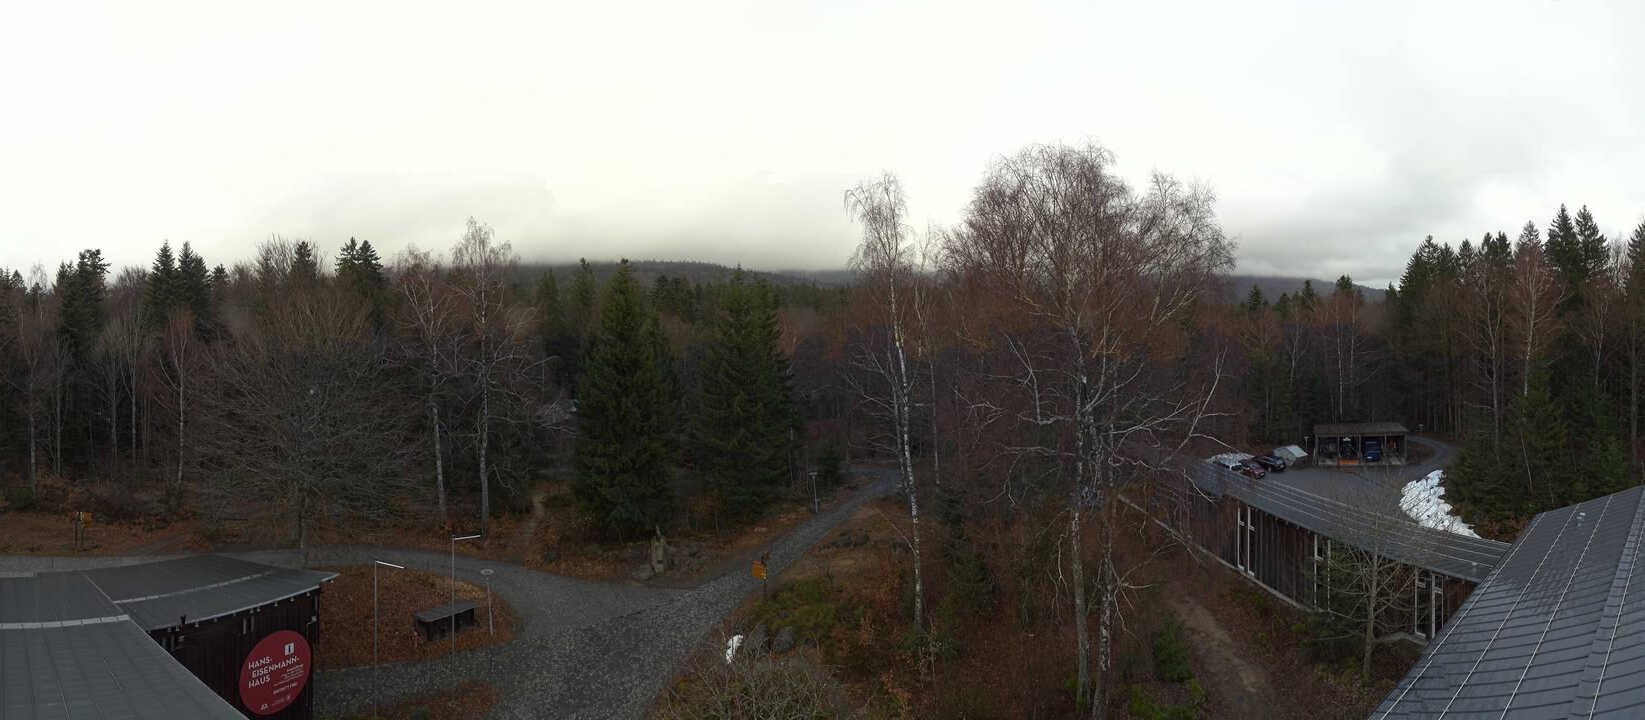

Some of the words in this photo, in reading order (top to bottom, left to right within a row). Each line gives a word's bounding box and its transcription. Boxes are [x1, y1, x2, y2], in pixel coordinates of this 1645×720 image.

[248, 656, 273, 670] HANS-
[252, 656, 300, 678] EISENMANN-
[248, 675, 271, 688] HAUS
